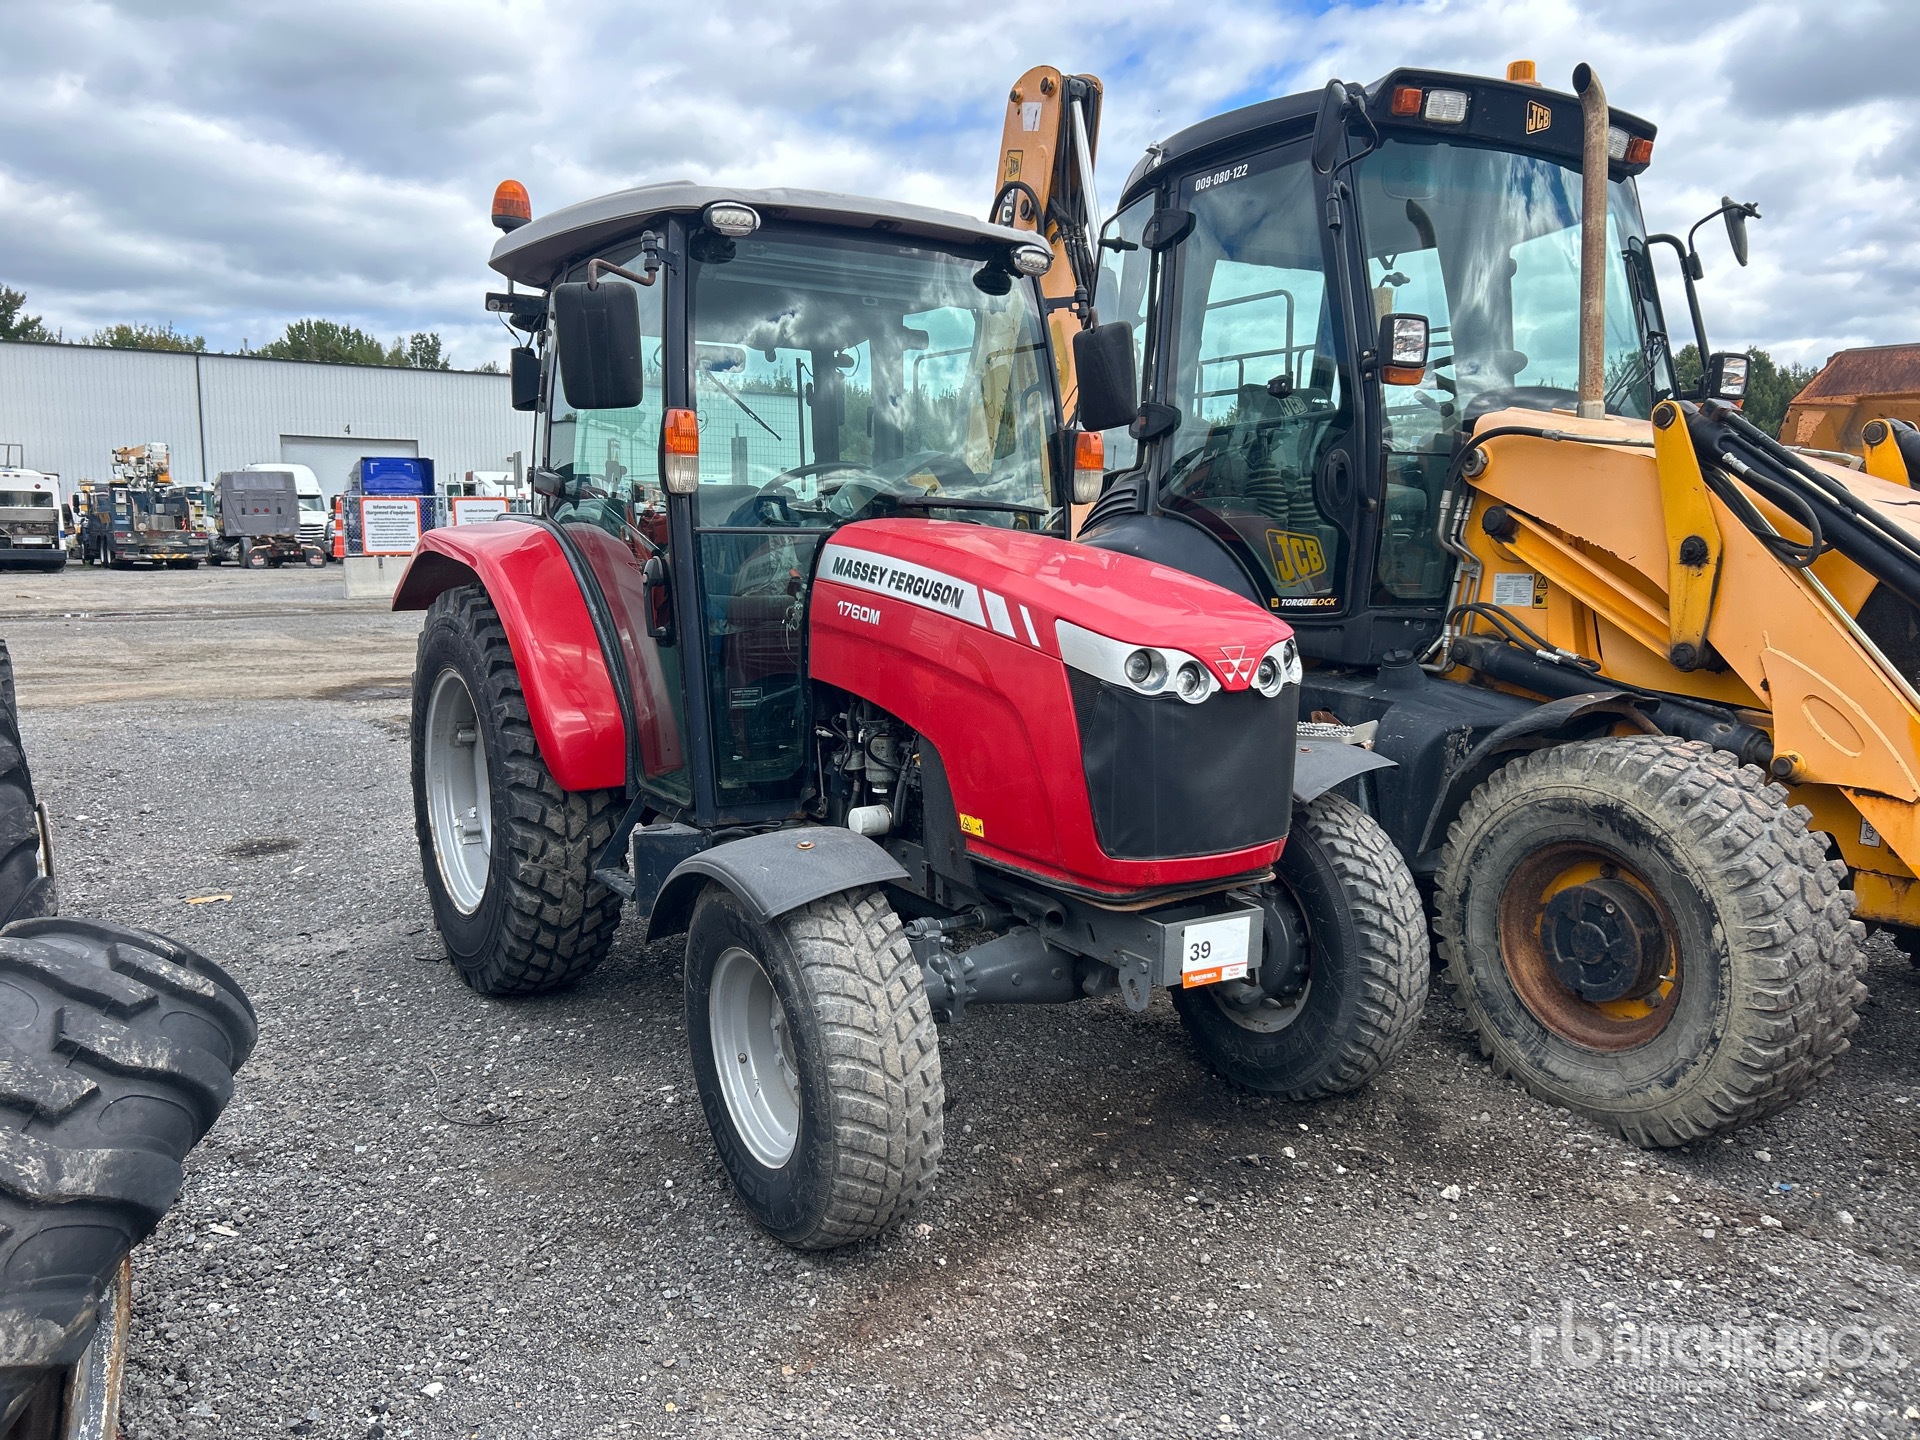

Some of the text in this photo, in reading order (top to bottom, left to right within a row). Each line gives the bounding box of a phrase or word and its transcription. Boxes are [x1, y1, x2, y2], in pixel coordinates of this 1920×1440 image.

[1528, 104, 1549, 131] JCB
[1195, 163, 1248, 192] 009-080-122
[1282, 397, 1305, 417] JCB
[344, 423, 351, 435] 4
[1275, 535, 1323, 581] JCB
[832, 556, 965, 610] MASSEY FERGUSON
[836, 600, 881, 626] 1760M
[1281, 598, 1338, 607] TORQUELOCK
[1189, 940, 1211, 962] 39
